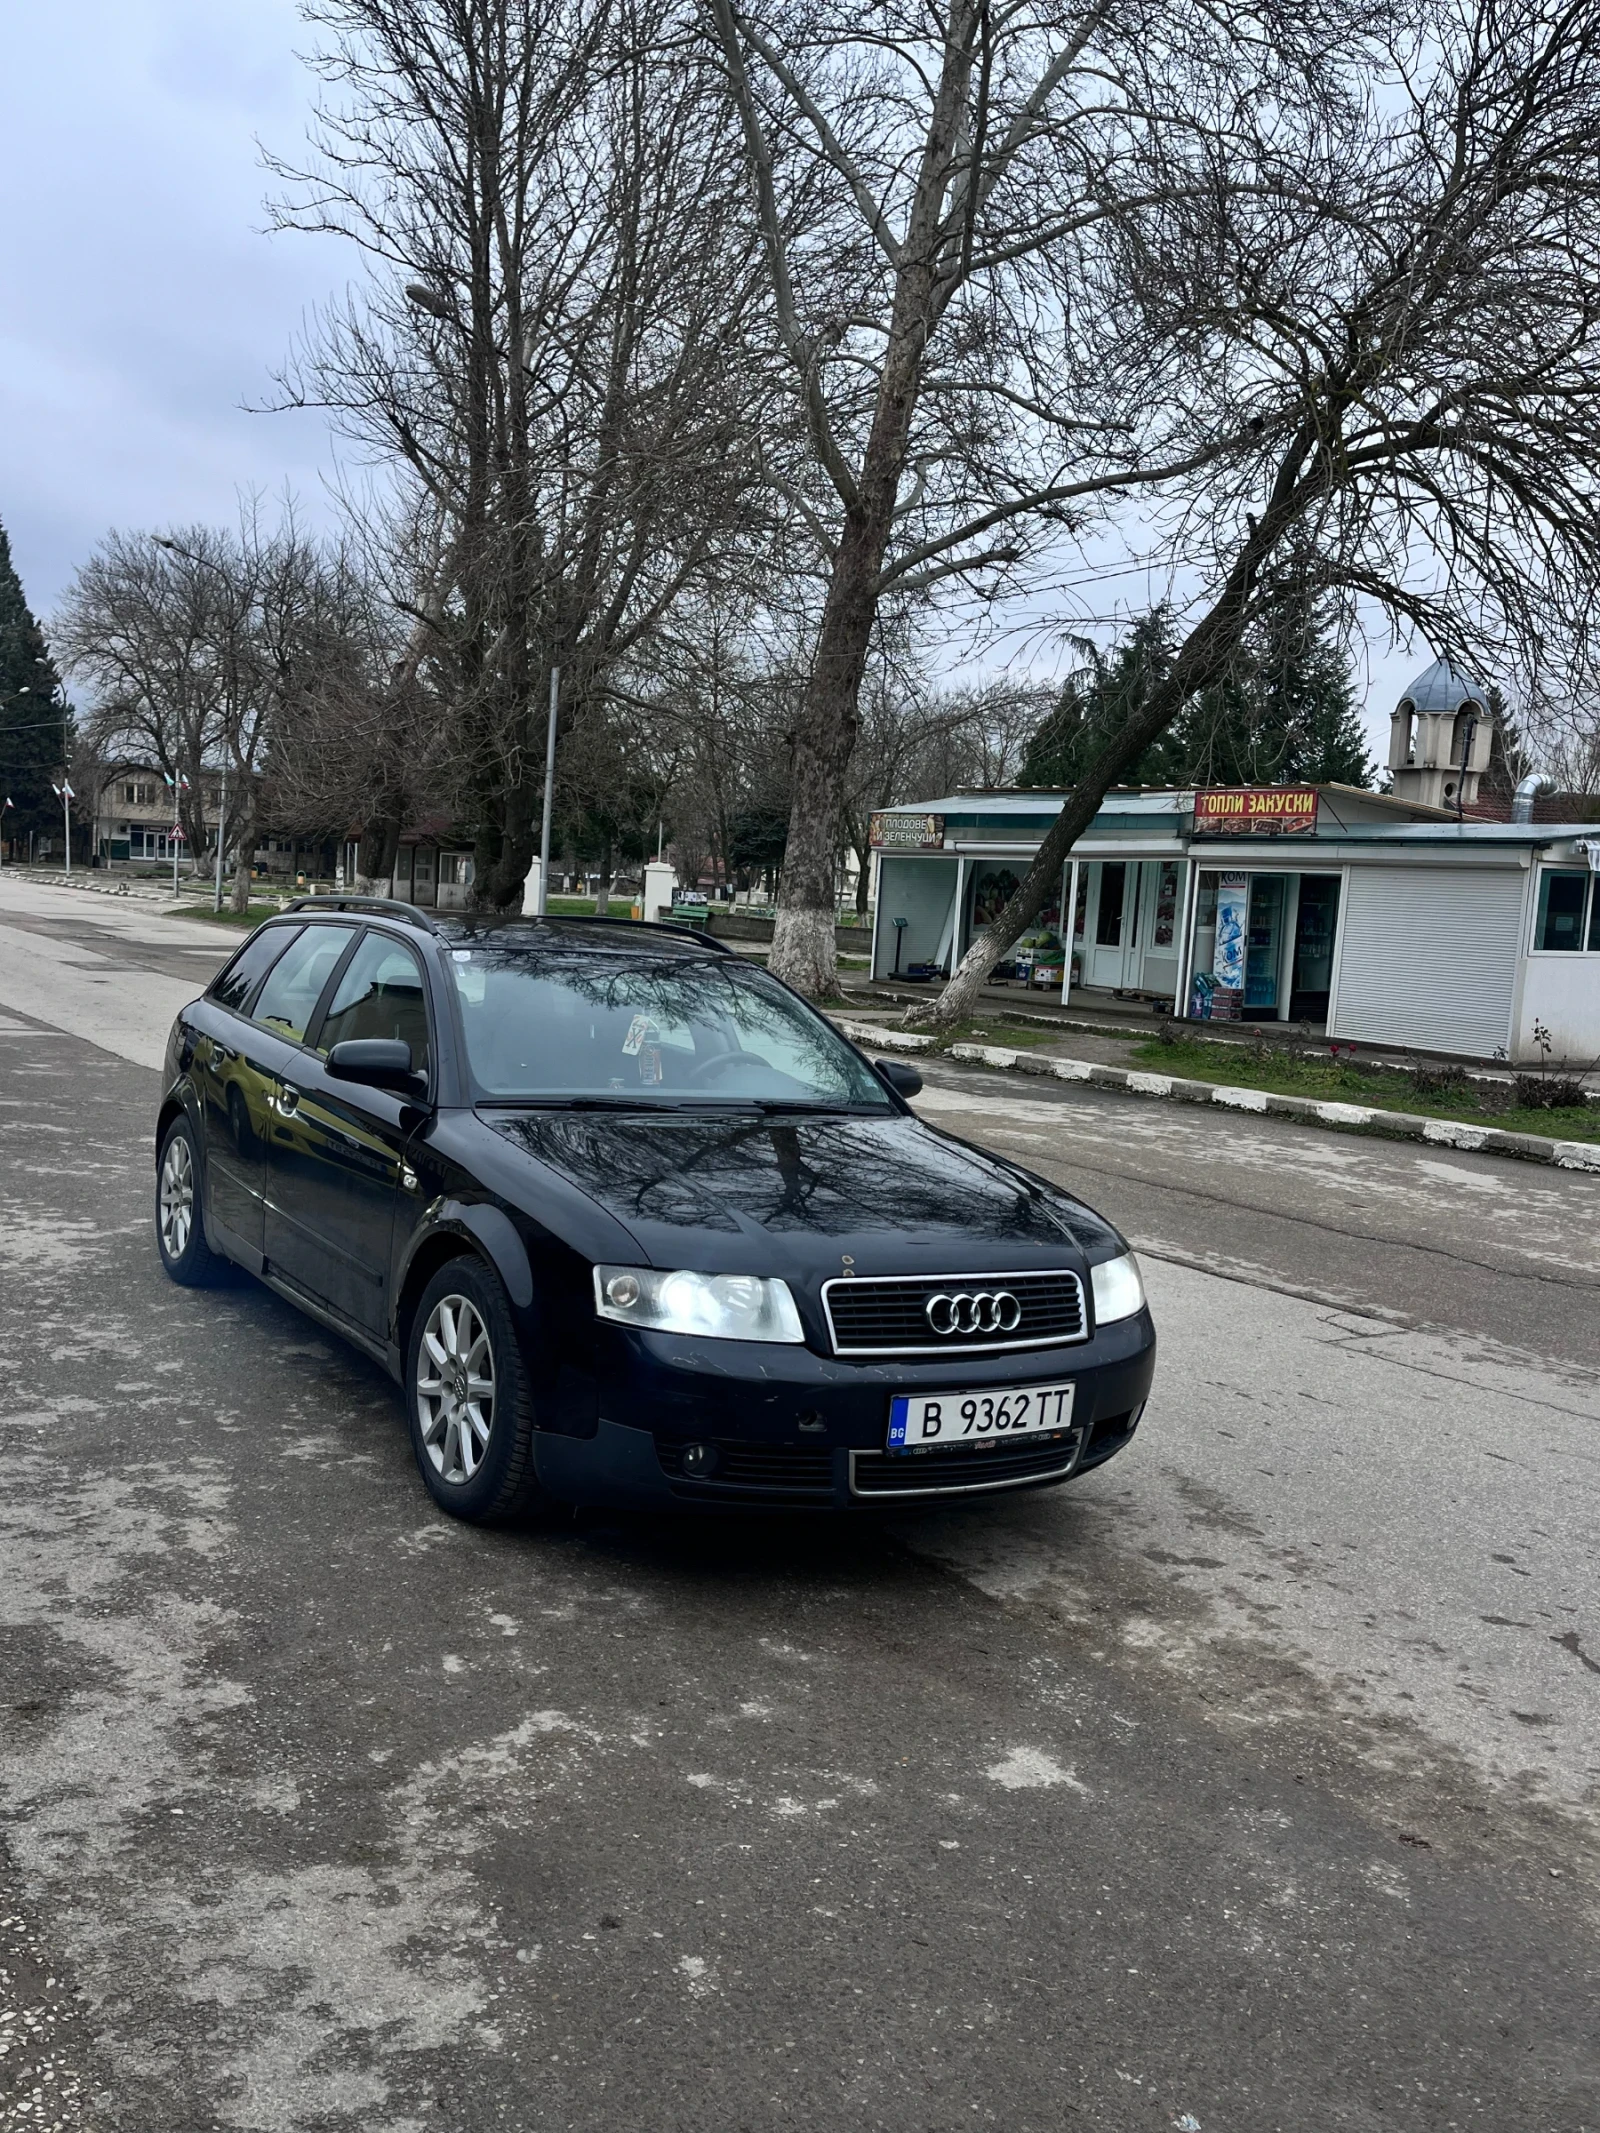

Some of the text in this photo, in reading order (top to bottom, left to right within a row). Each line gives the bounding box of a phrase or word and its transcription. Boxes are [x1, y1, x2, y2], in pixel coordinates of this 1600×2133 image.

[1201, 794, 1314, 814] ТОПЛИ ЗАКУСКИ
[886, 818, 927, 830] ПЛОДОВЕ
[876, 831, 936, 843] И ЗЕЛЕНЧУЦИ
[922, 1402, 942, 1438] B
[890, 1427, 905, 1439] BG
